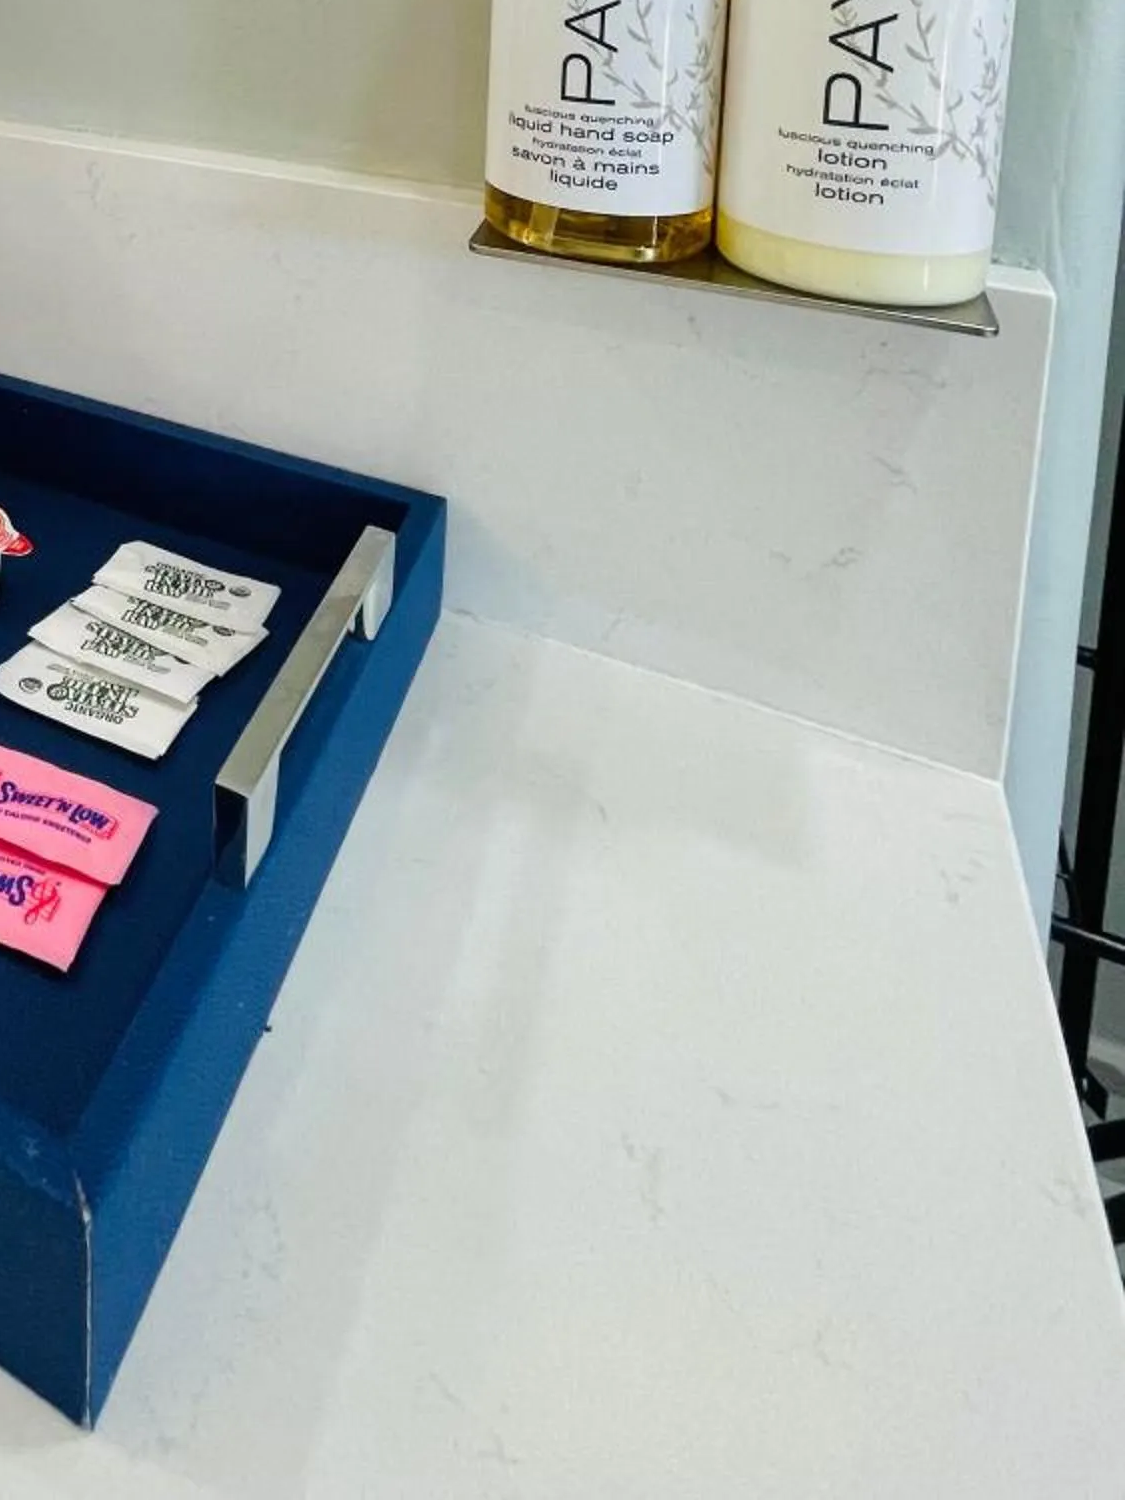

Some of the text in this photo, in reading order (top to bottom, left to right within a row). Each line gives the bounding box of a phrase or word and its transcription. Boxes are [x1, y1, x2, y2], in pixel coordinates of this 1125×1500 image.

[524, 103, 654, 127] luscious quenching
[508, 110, 675, 147] liquid hand soap
[777, 125, 935, 156] luscious quenching
[511, 145, 661, 176] savon à mains
[817, 148, 888, 171] lotion
[549, 168, 619, 192] liquide
[785, 162, 875, 187] hydratation
[814, 181, 885, 205] lotion
